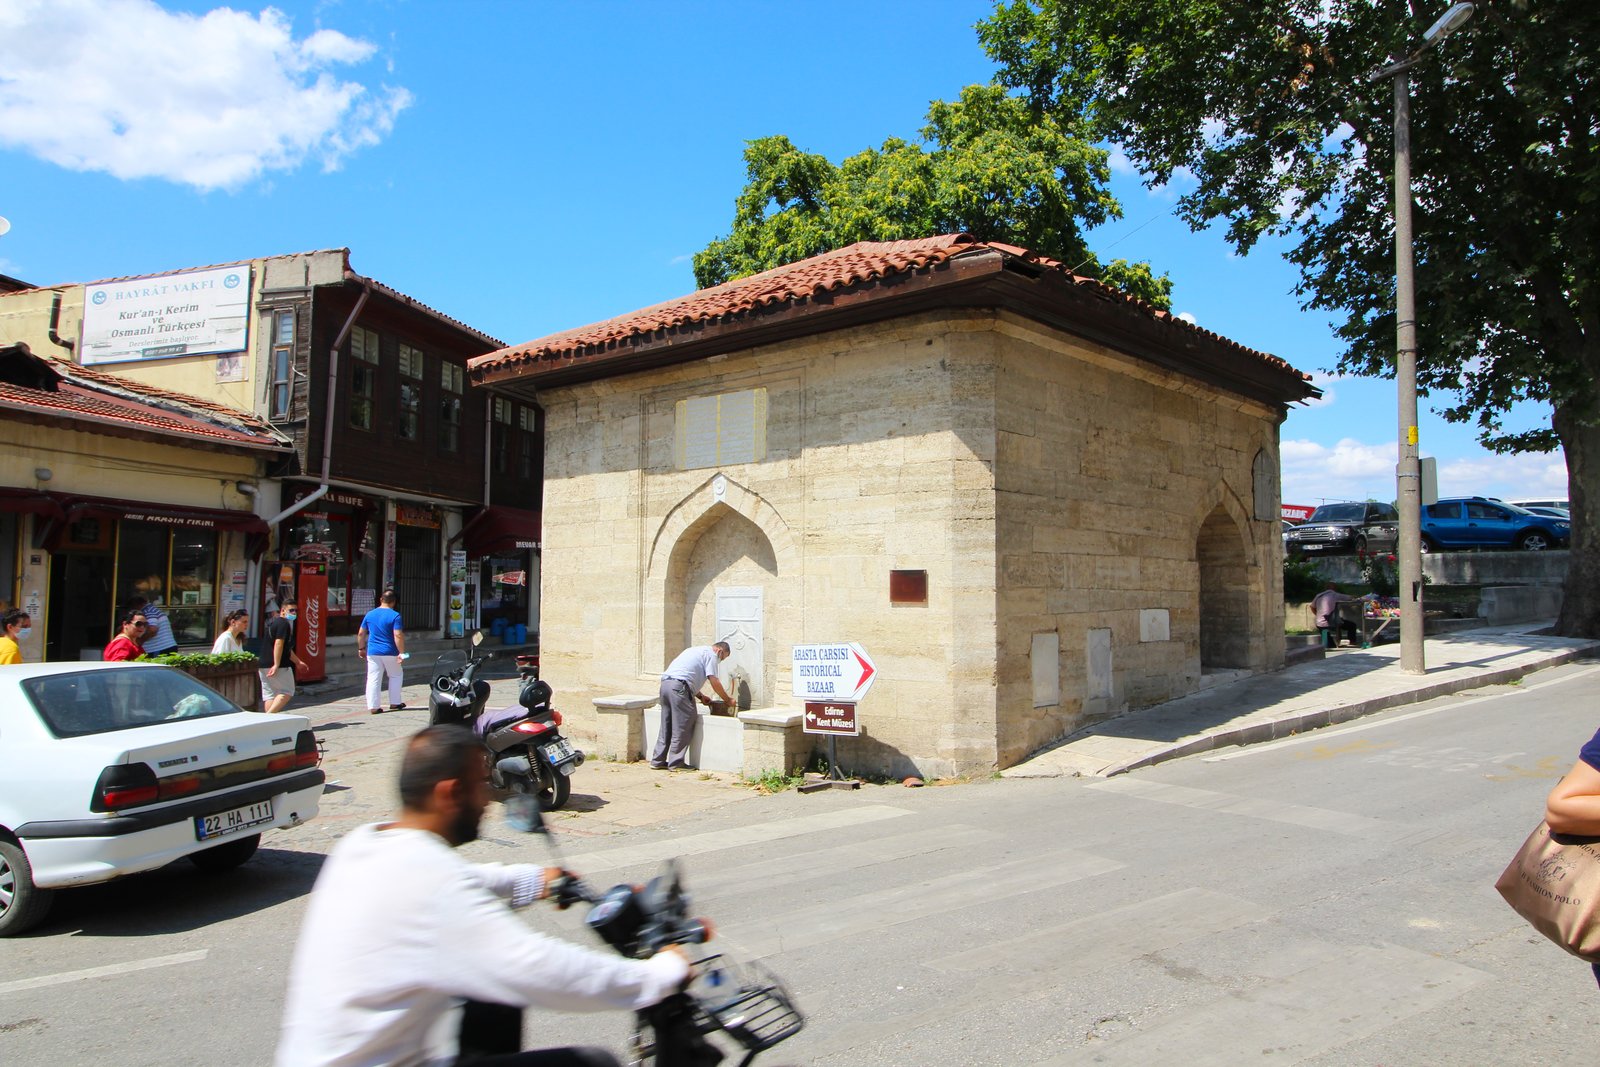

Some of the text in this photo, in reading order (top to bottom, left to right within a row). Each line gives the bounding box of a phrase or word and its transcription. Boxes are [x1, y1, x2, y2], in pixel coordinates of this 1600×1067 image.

[116, 280, 214, 300] HAYRÂT VAKFI
[166, 303, 199, 315] Kerim
[152, 316, 165, 324] ve
[111, 319, 206, 338] Osmanlı Türkçesi
[794, 648, 817, 661] ARASTA
[800, 665, 842, 677] HISTORICAL
[807, 681, 835, 693] BAZAAR
[824, 706, 845, 716] Edirne
[817, 718, 854, 728] Kent Müzesi
[206, 816, 221, 832] 22
[227, 810, 243, 826] HA
[249, 803, 269, 819] 111
[1554, 893, 1581, 906] POLO
